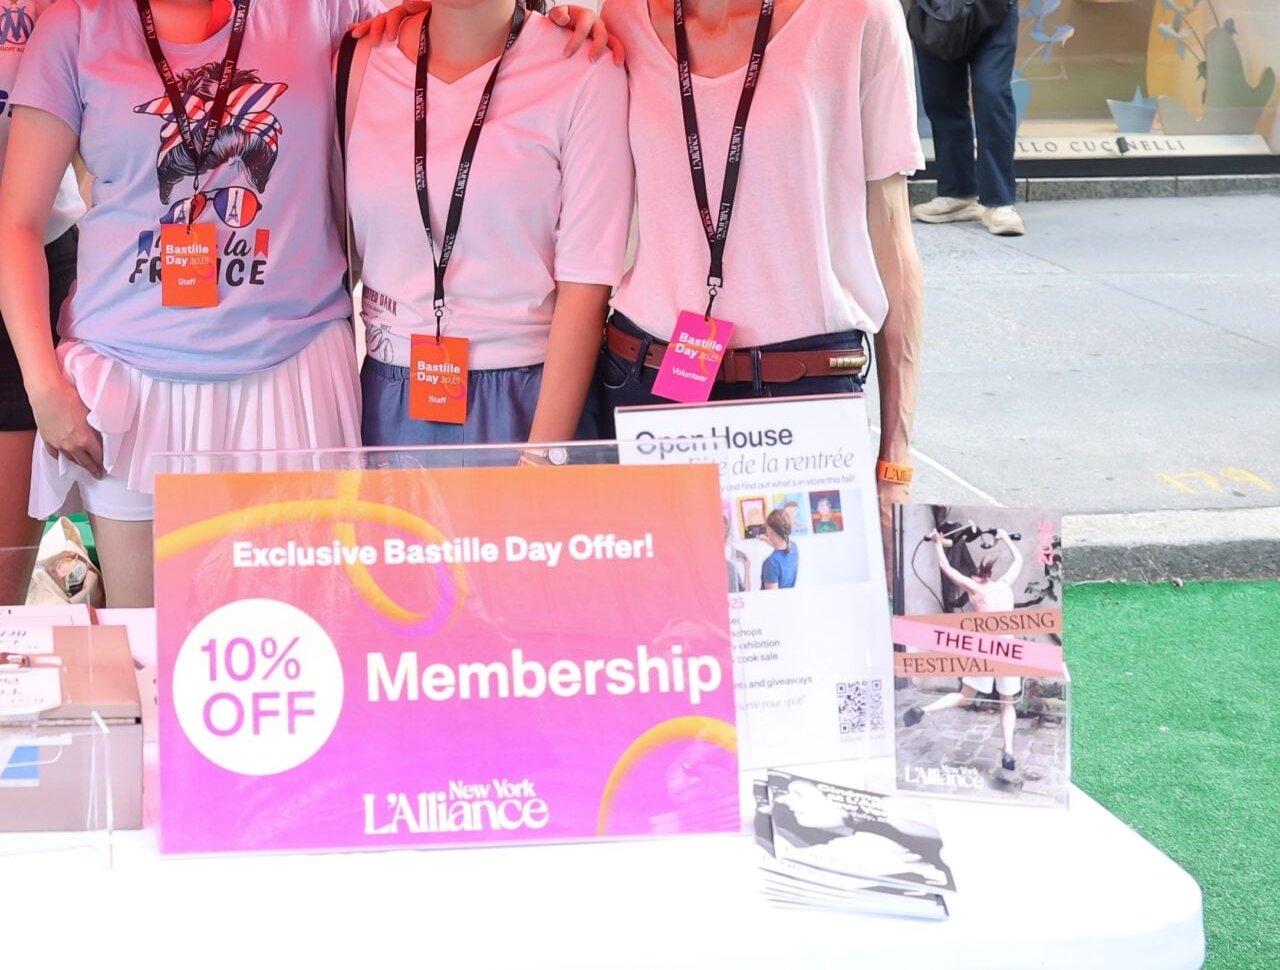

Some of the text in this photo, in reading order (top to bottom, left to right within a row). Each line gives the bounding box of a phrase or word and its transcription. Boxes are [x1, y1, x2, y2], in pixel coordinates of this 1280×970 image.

[1069, 138, 1185, 153] CUCNELLI
[165, 244, 209, 254] Bastille
[223, 230, 252, 256] la
[166, 255, 188, 267] Day
[128, 257, 267, 287] FRCE
[178, 278, 196, 286] Staff
[674, 342, 698, 360] Day
[678, 331, 723, 352] Bastille
[416, 371, 439, 384] Day
[417, 360, 461, 374] Bastille
[672, 366, 708, 383] Volunteer
[428, 395, 447, 404] Staff
[635, 426, 793, 460] Open House
[732, 456, 756, 476] de
[761, 452, 779, 474] la
[784, 447, 855, 473] rentrée
[741, 482, 757, 491] find
[757, 481, 771, 490] out
[772, 479, 797, 488] what's
[798, 479, 804, 487] in
[806, 477, 825, 486] store
[826, 476, 840, 485] this
[231, 533, 654, 569] Exclusive Bastille Day Offer!
[960, 612, 1055, 633] CROSSING
[933, 630, 1024, 660] THE LINE
[200, 637, 301, 682] 10%
[760, 652, 779, 662] sale
[902, 657, 994, 674] FESTIVAL
[366, 645, 722, 705] Membership
[748, 678, 765, 688] and
[767, 675, 813, 689] giveaways
[202, 690, 316, 737] OFF
[904, 765, 984, 789] L'Alliance
[448, 778, 536, 800] New York
[362, 790, 549, 835] L'Alliance
